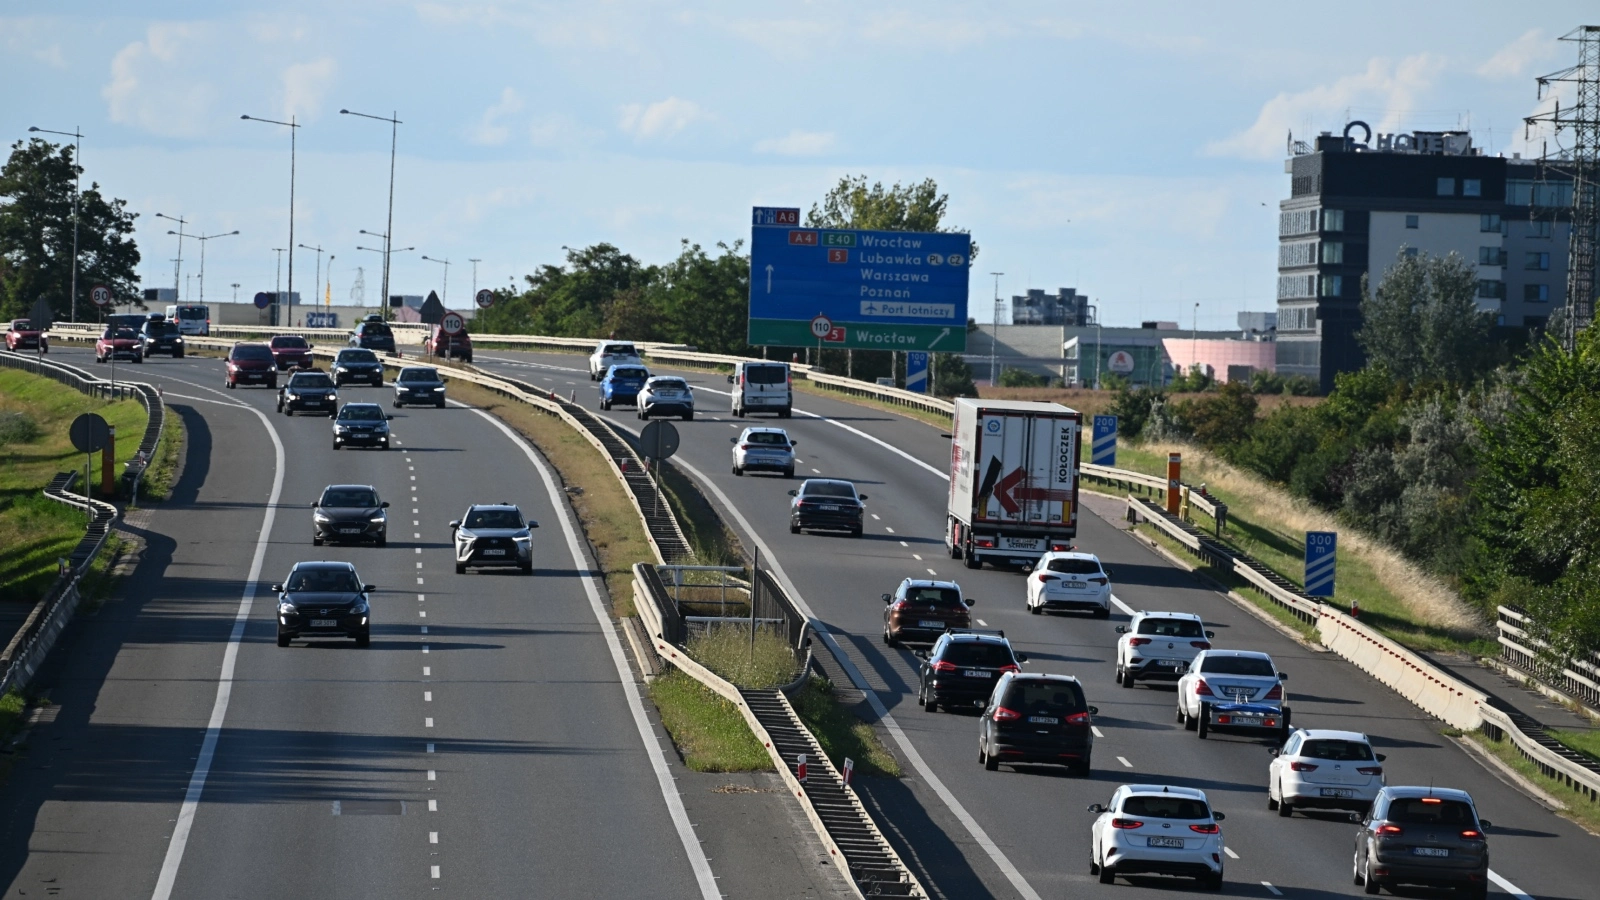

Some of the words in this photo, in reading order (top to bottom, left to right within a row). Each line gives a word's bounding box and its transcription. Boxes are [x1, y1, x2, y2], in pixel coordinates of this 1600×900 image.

[779, 211, 795, 223] A8
[795, 233, 812, 243] A4
[828, 234, 850, 245] E40
[861, 235, 922, 249] Wrocław
[834, 251, 842, 261] 5
[860, 252, 921, 265] Lubawka
[929, 255, 941, 264] PL
[950, 256, 961, 265] CZ
[860, 269, 930, 283] Warszawa
[93, 290, 108, 301] 80
[860, 286, 911, 299] Poznań
[882, 304, 904, 315] Port
[908, 305, 950, 317] lotniczy
[445, 319, 460, 329] 110
[814, 322, 830, 332] 110
[831, 330, 839, 340] 5
[856, 330, 917, 344] Wrocław
[911, 353, 925, 361] 100
[1096, 418, 1114, 427] 200
[1058, 427, 1070, 483] KOŁOCZEK
[1309, 534, 1332, 545] 300
